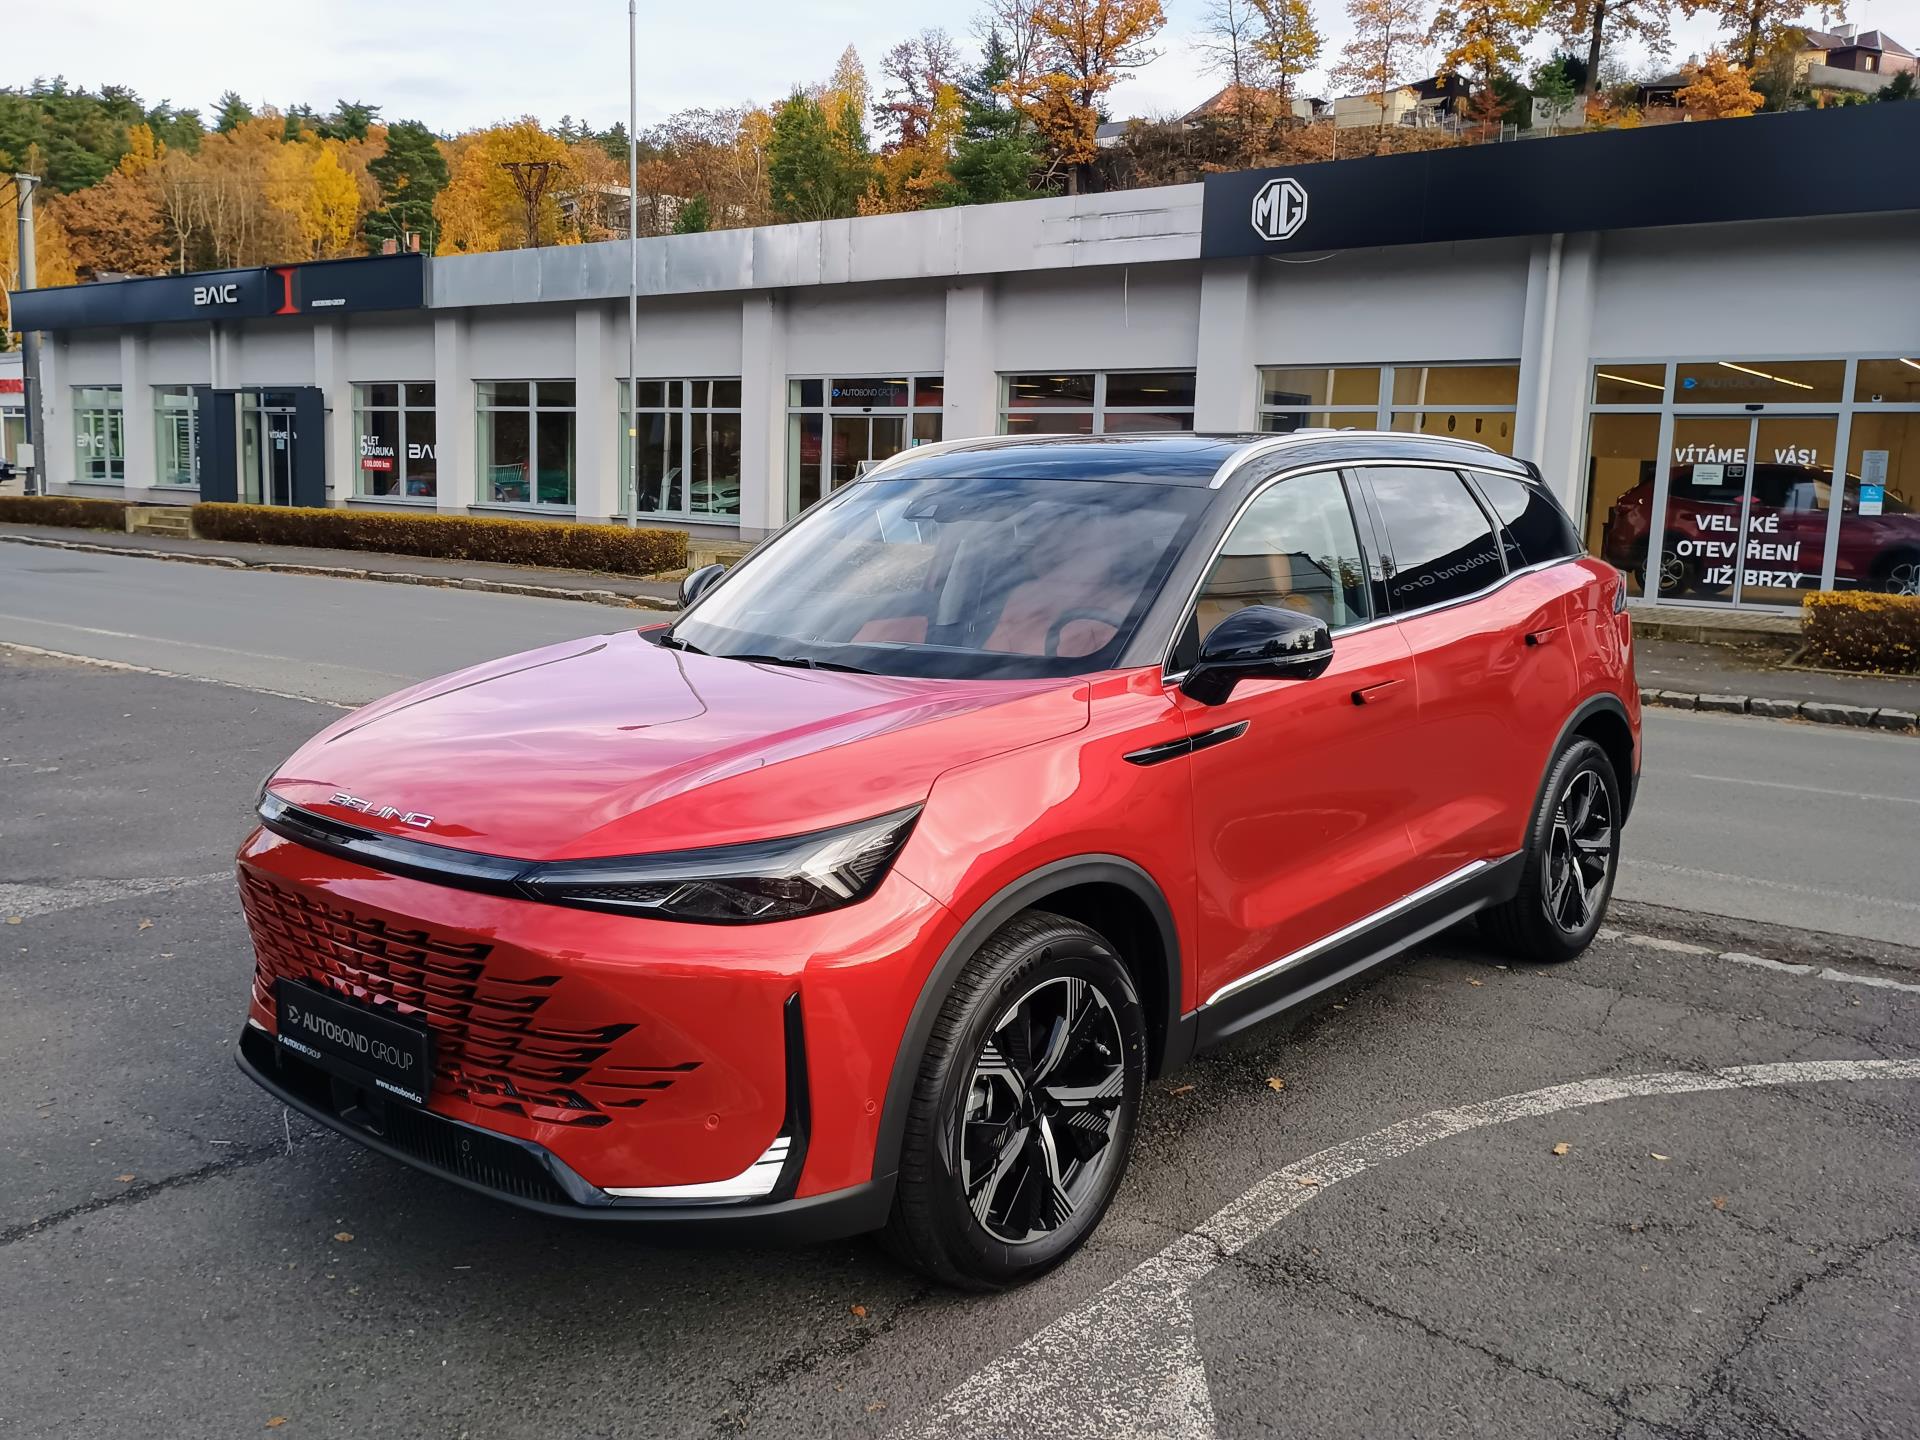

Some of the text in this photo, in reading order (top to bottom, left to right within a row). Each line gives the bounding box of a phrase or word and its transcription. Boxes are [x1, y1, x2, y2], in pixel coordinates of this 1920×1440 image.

[1256, 183, 1303, 235] MG
[193, 284, 238, 306] BAIC
[841, 388, 878, 397] AUTOBOND
[360, 434, 368, 456] 5
[367, 445, 395, 457] ZÁRUKA
[1675, 443, 1817, 465] VÍTÁME VÁS!
[1695, 512, 1780, 534] VELKÉ
[1702, 564, 1803, 589] JIŽ BRZY
[329, 792, 436, 828] BEIJING
[302, 1011, 413, 1071] AUTOBOND GROUP
[375, 1078, 423, 1104] www.autobond.cz
